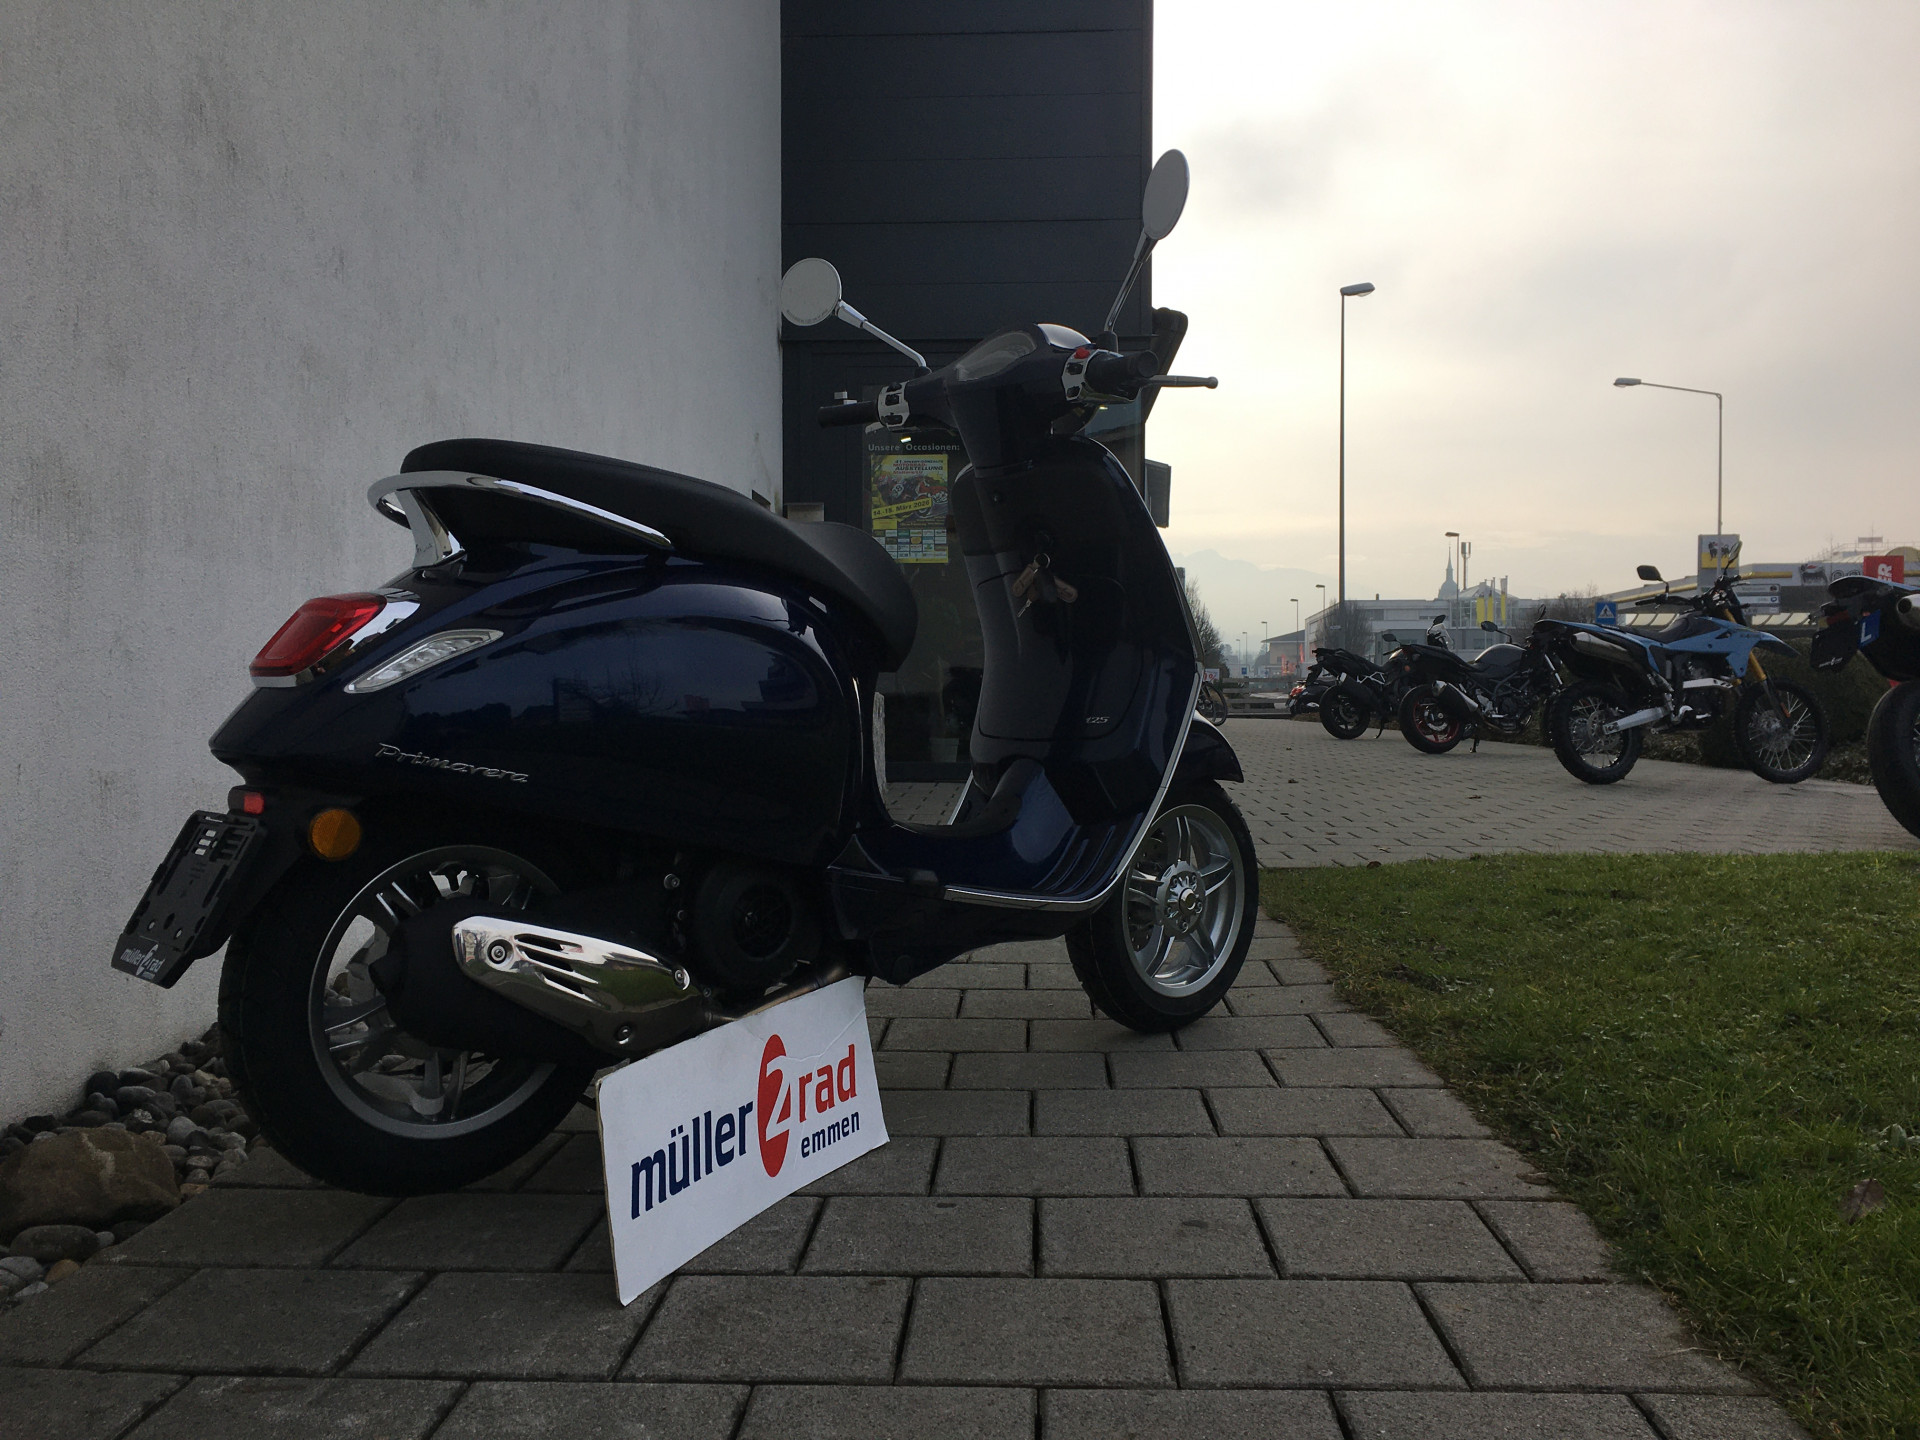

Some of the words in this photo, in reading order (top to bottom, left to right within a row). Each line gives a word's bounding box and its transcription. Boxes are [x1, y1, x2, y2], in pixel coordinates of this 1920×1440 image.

[868, 443, 901, 451] Unsere
[905, 443, 960, 451] Occasionen:
[895, 504, 912, 512] März
[1860, 621, 1872, 643] L
[1086, 716, 1111, 724] 125
[374, 742, 529, 783] Primavera
[801, 1111, 860, 1158] emmen
[630, 1100, 754, 1220] müller
